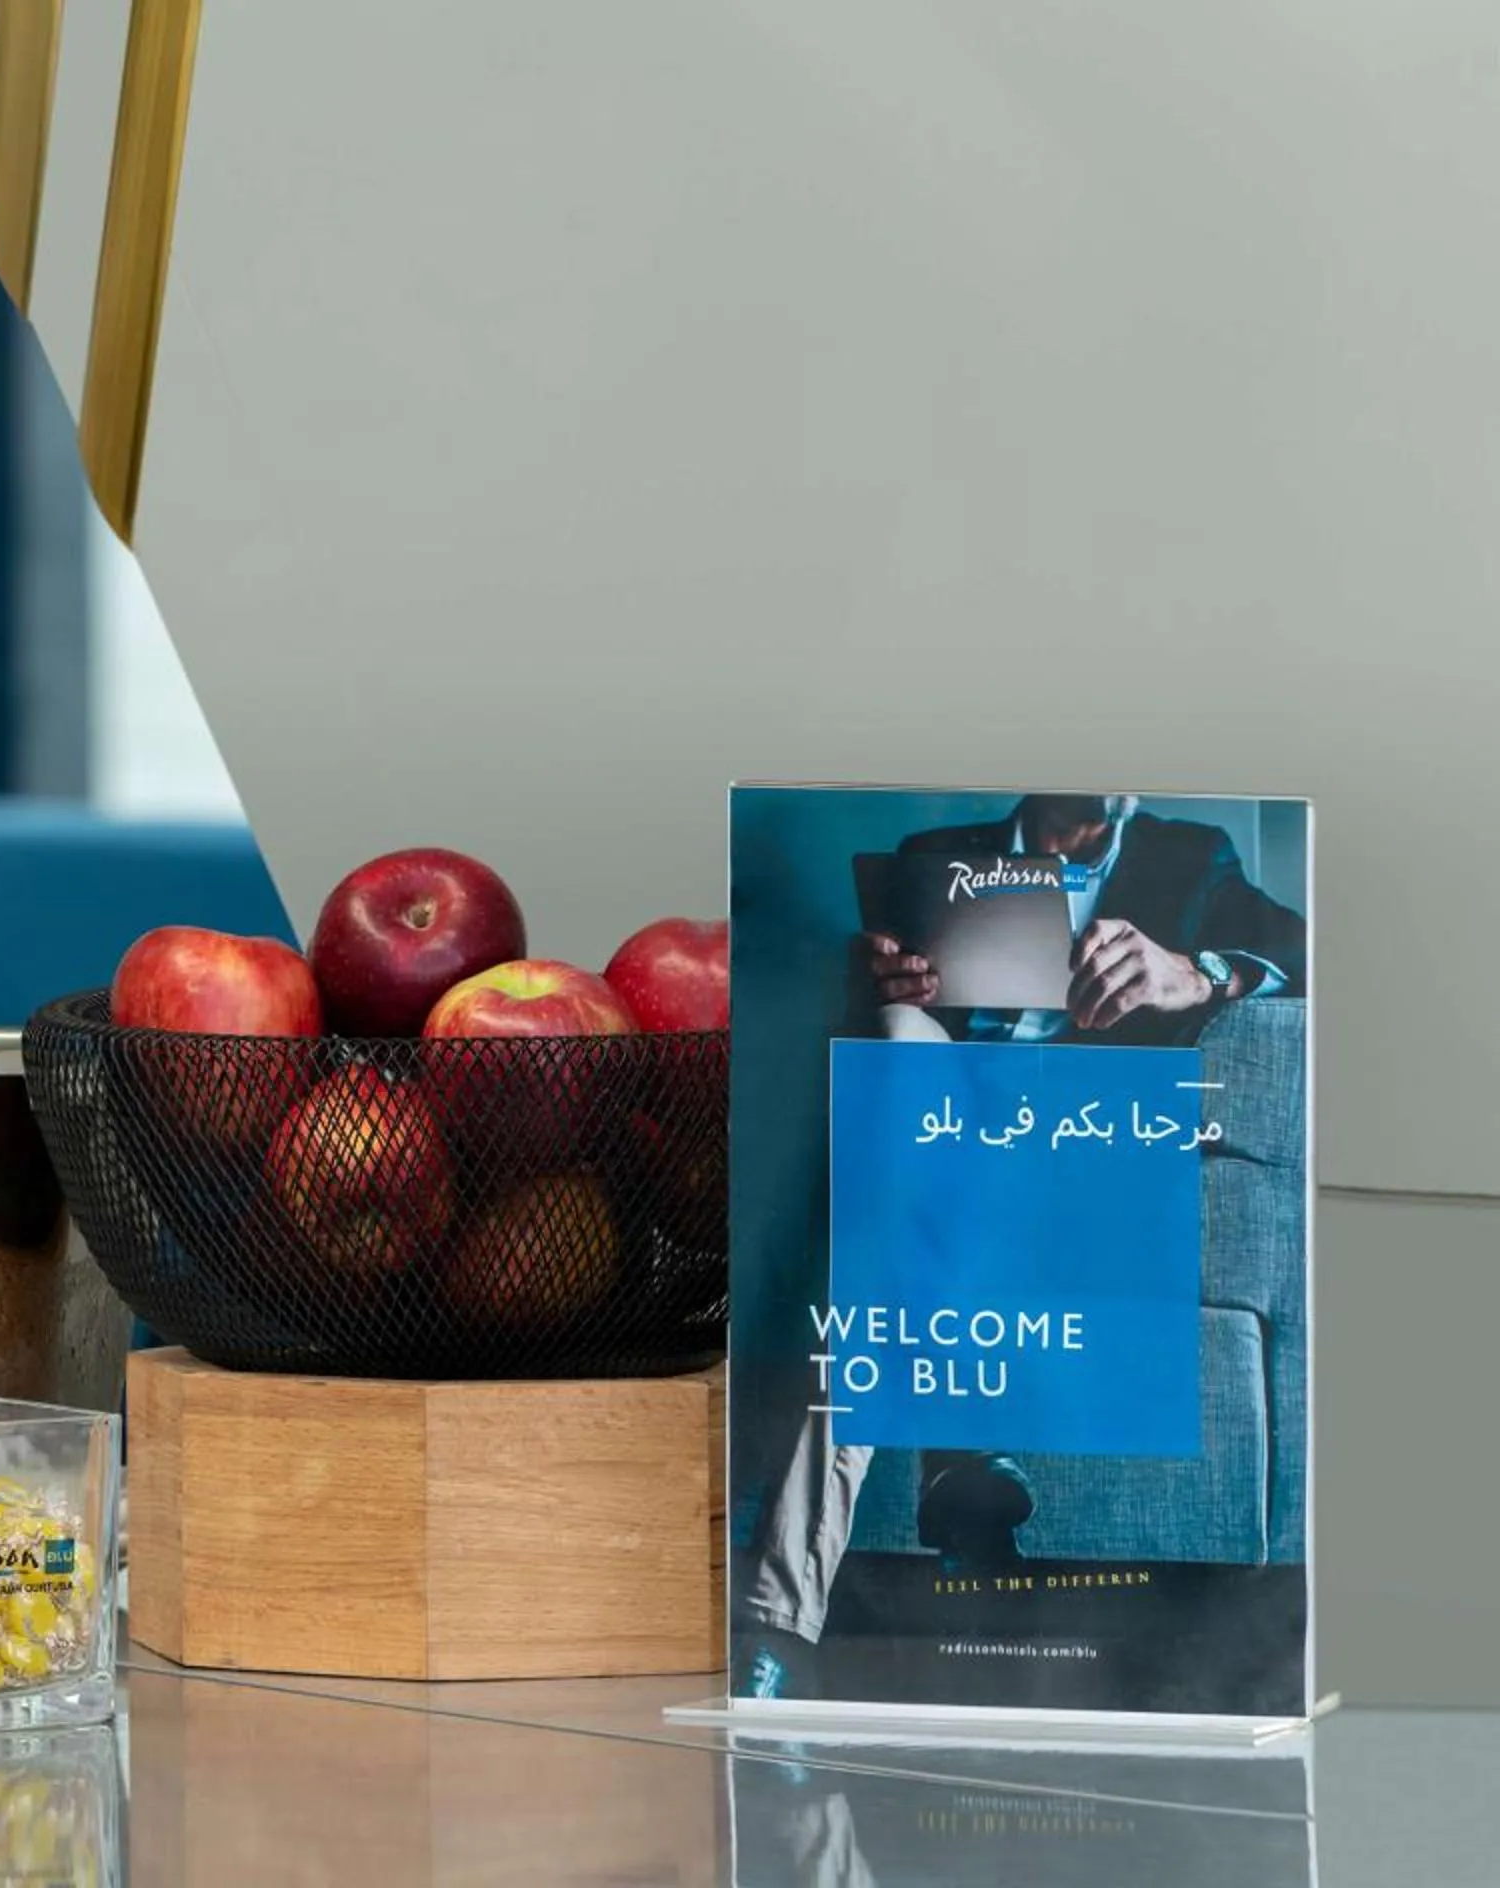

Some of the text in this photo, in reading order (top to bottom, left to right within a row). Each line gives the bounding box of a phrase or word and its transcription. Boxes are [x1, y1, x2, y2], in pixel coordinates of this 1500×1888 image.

[948, 856, 1059, 903] Radisson
[915, 1095, 1223, 1151] مرحبا بكم في بلو
[809, 1304, 1084, 1350] WELCOME
[809, 1353, 1008, 1397] TO BLU
[995, 1577, 1034, 1591] THE
